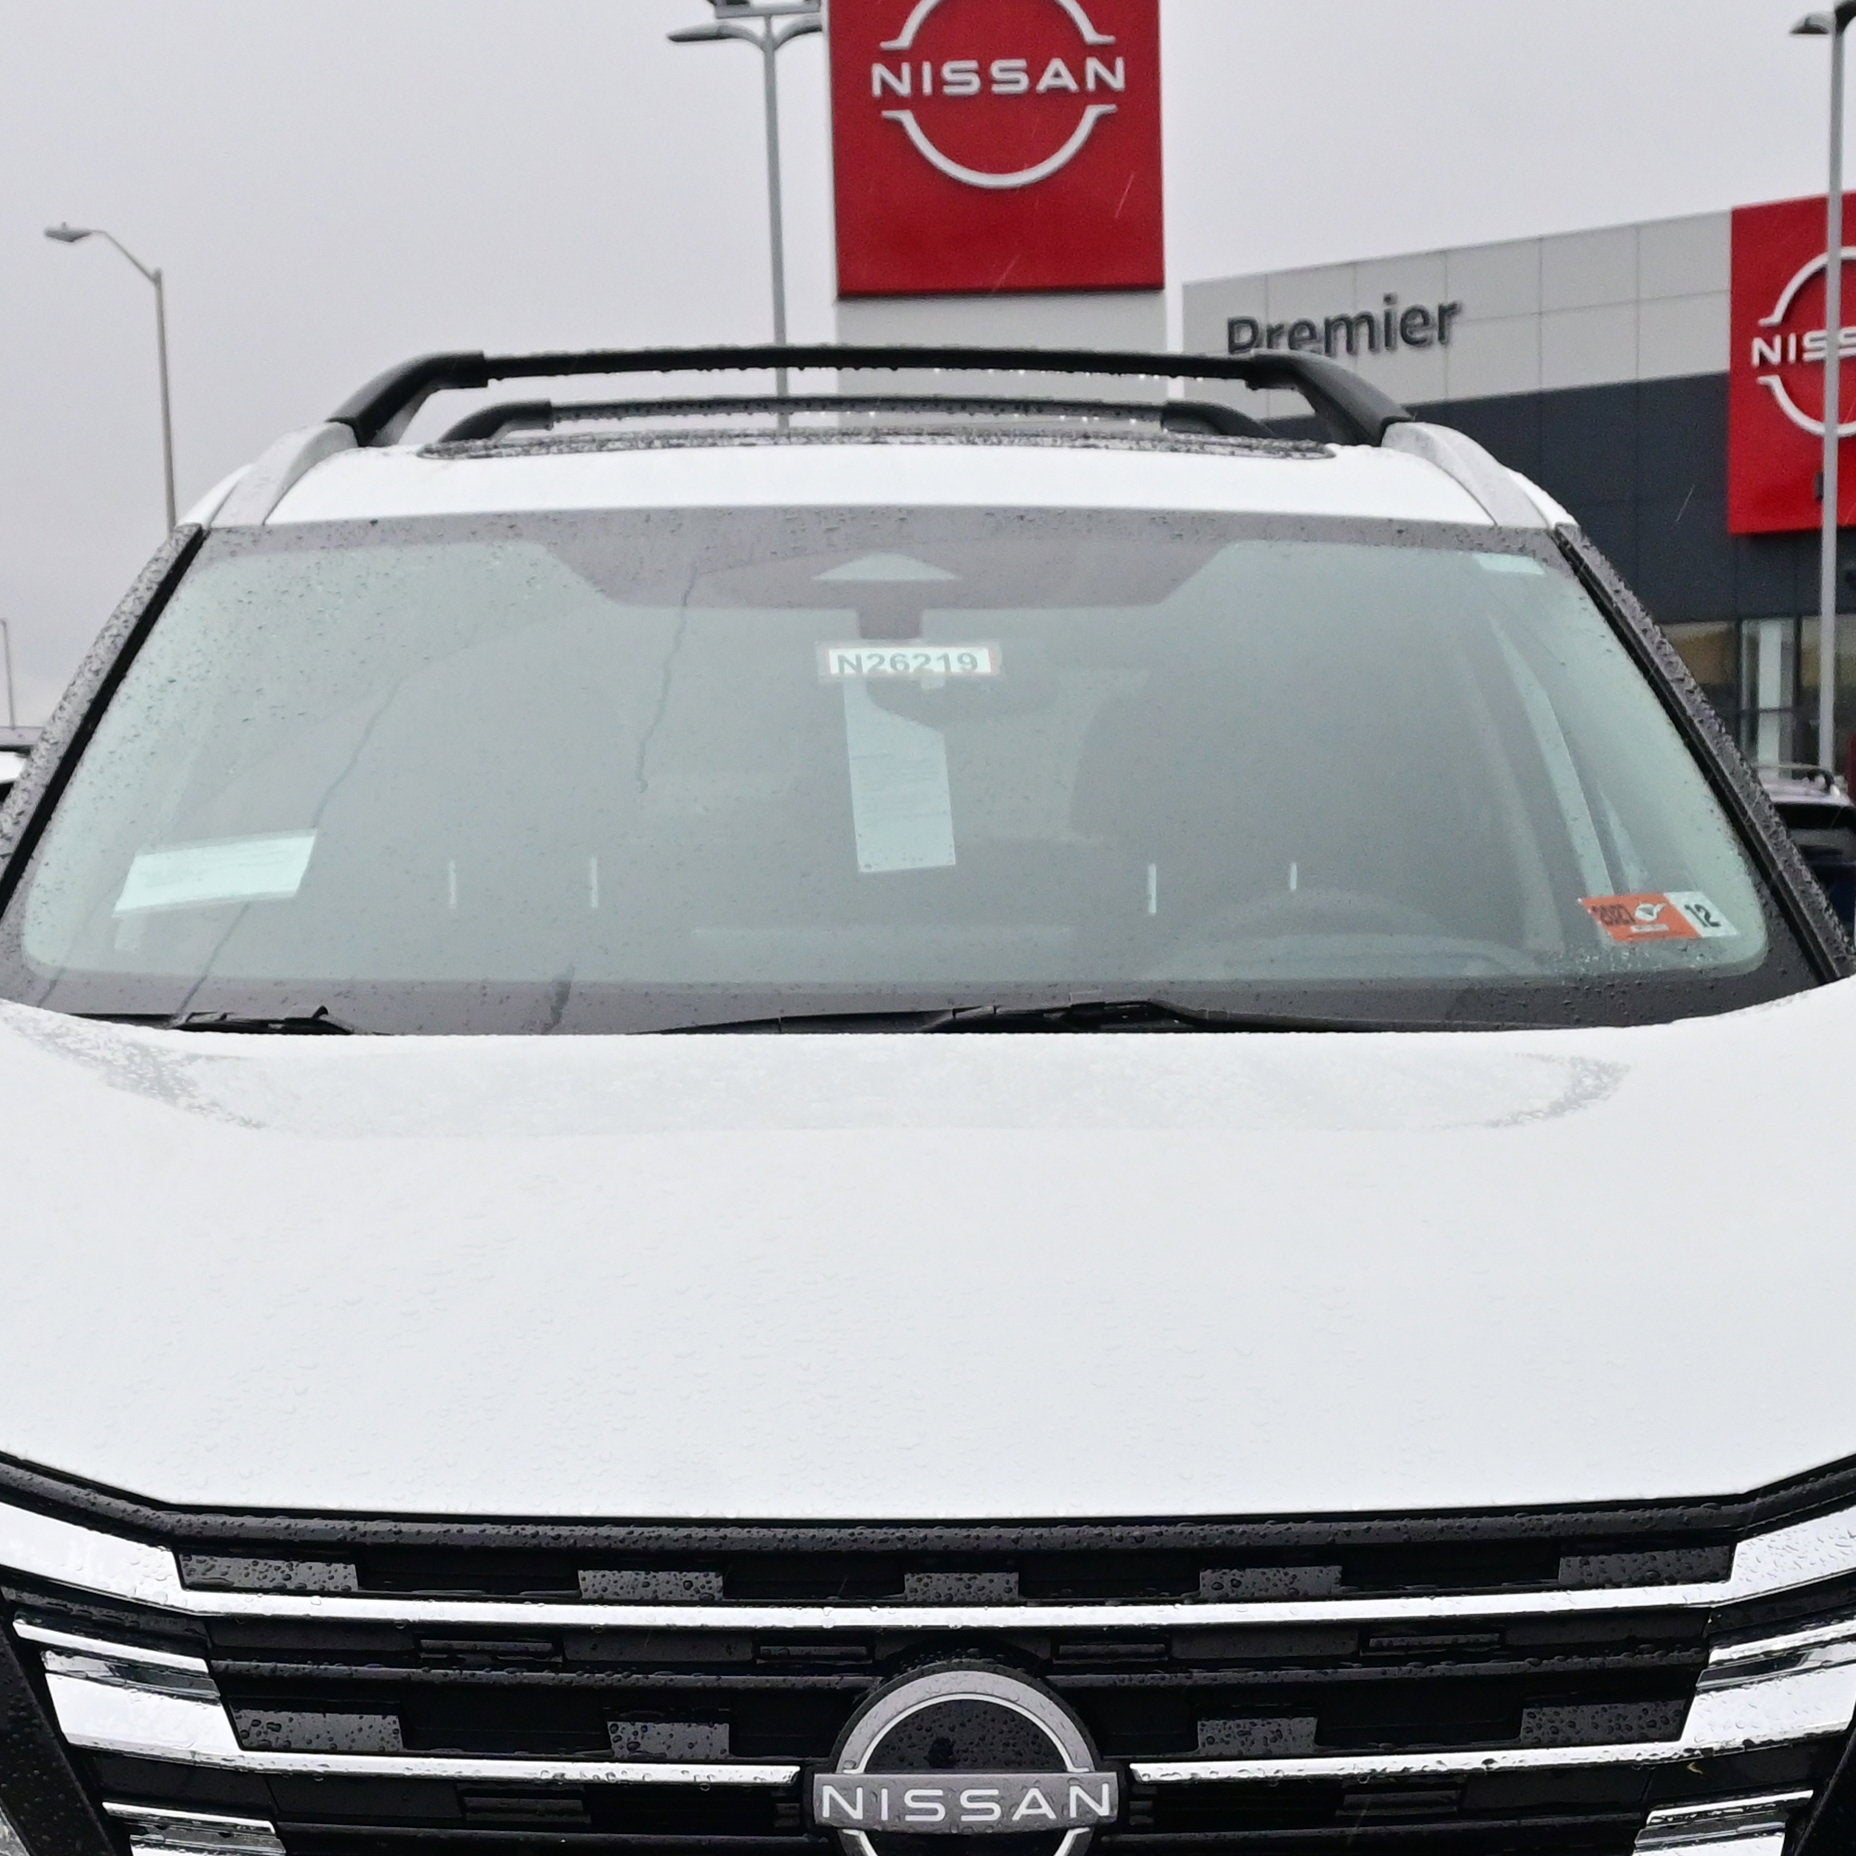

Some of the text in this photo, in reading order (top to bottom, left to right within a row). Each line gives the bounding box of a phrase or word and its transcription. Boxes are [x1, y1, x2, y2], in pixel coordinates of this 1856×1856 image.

[871, 56, 1126, 97] NISSAN
[1228, 293, 1461, 357] Premier
[837, 653, 979, 674] N26219
[1684, 903, 1721, 928] 12
[821, 1783, 1110, 1821] NISSAN
